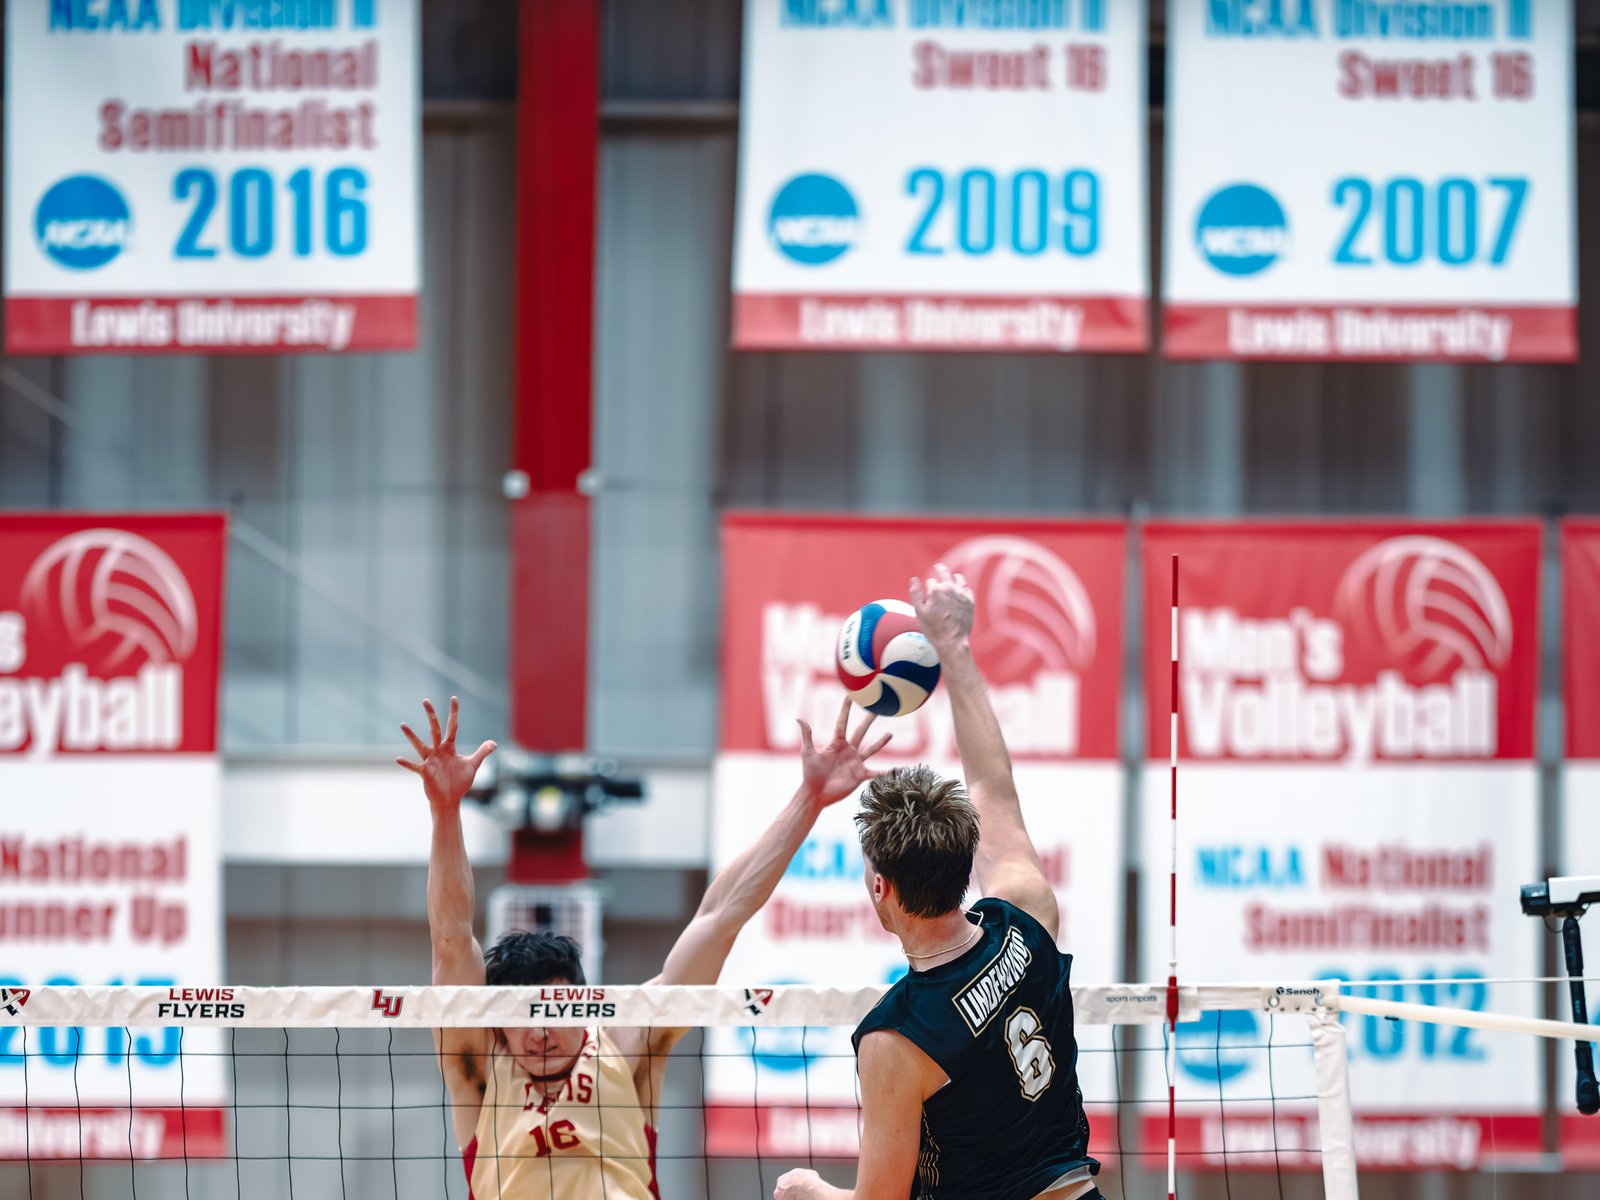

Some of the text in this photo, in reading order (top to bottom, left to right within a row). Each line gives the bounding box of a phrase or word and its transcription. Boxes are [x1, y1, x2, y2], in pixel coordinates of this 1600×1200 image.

[185, 42, 378, 90] National
[912, 41, 1105, 90] Sweet 16
[1338, 51, 1533, 99] Sweet 16
[99, 100, 376, 150] Semifinalist
[174, 168, 368, 257] 2016
[905, 168, 1100, 256] 2009
[1331, 177, 1527, 266] 2007
[72, 299, 354, 350] Lewis University
[801, 301, 1083, 351] Lewis University
[1228, 310, 1510, 358] Lewis University
[1183, 608, 1343, 680] Men's
[1183, 671, 1497, 767] Volleyball
[1196, 842, 1494, 890] NCAA National
[132, 895, 186, 950] Up
[1243, 902, 1489, 951] Semifinalist
[158, 1003, 245, 1018] FLYERS
[169, 988, 234, 1001] LEWIS
[529, 1003, 616, 1018] FLYERS
[540, 988, 605, 1000] LEWIS
[1004, 1006, 1056, 1102] 6
[529, 1119, 580, 1157] 16
